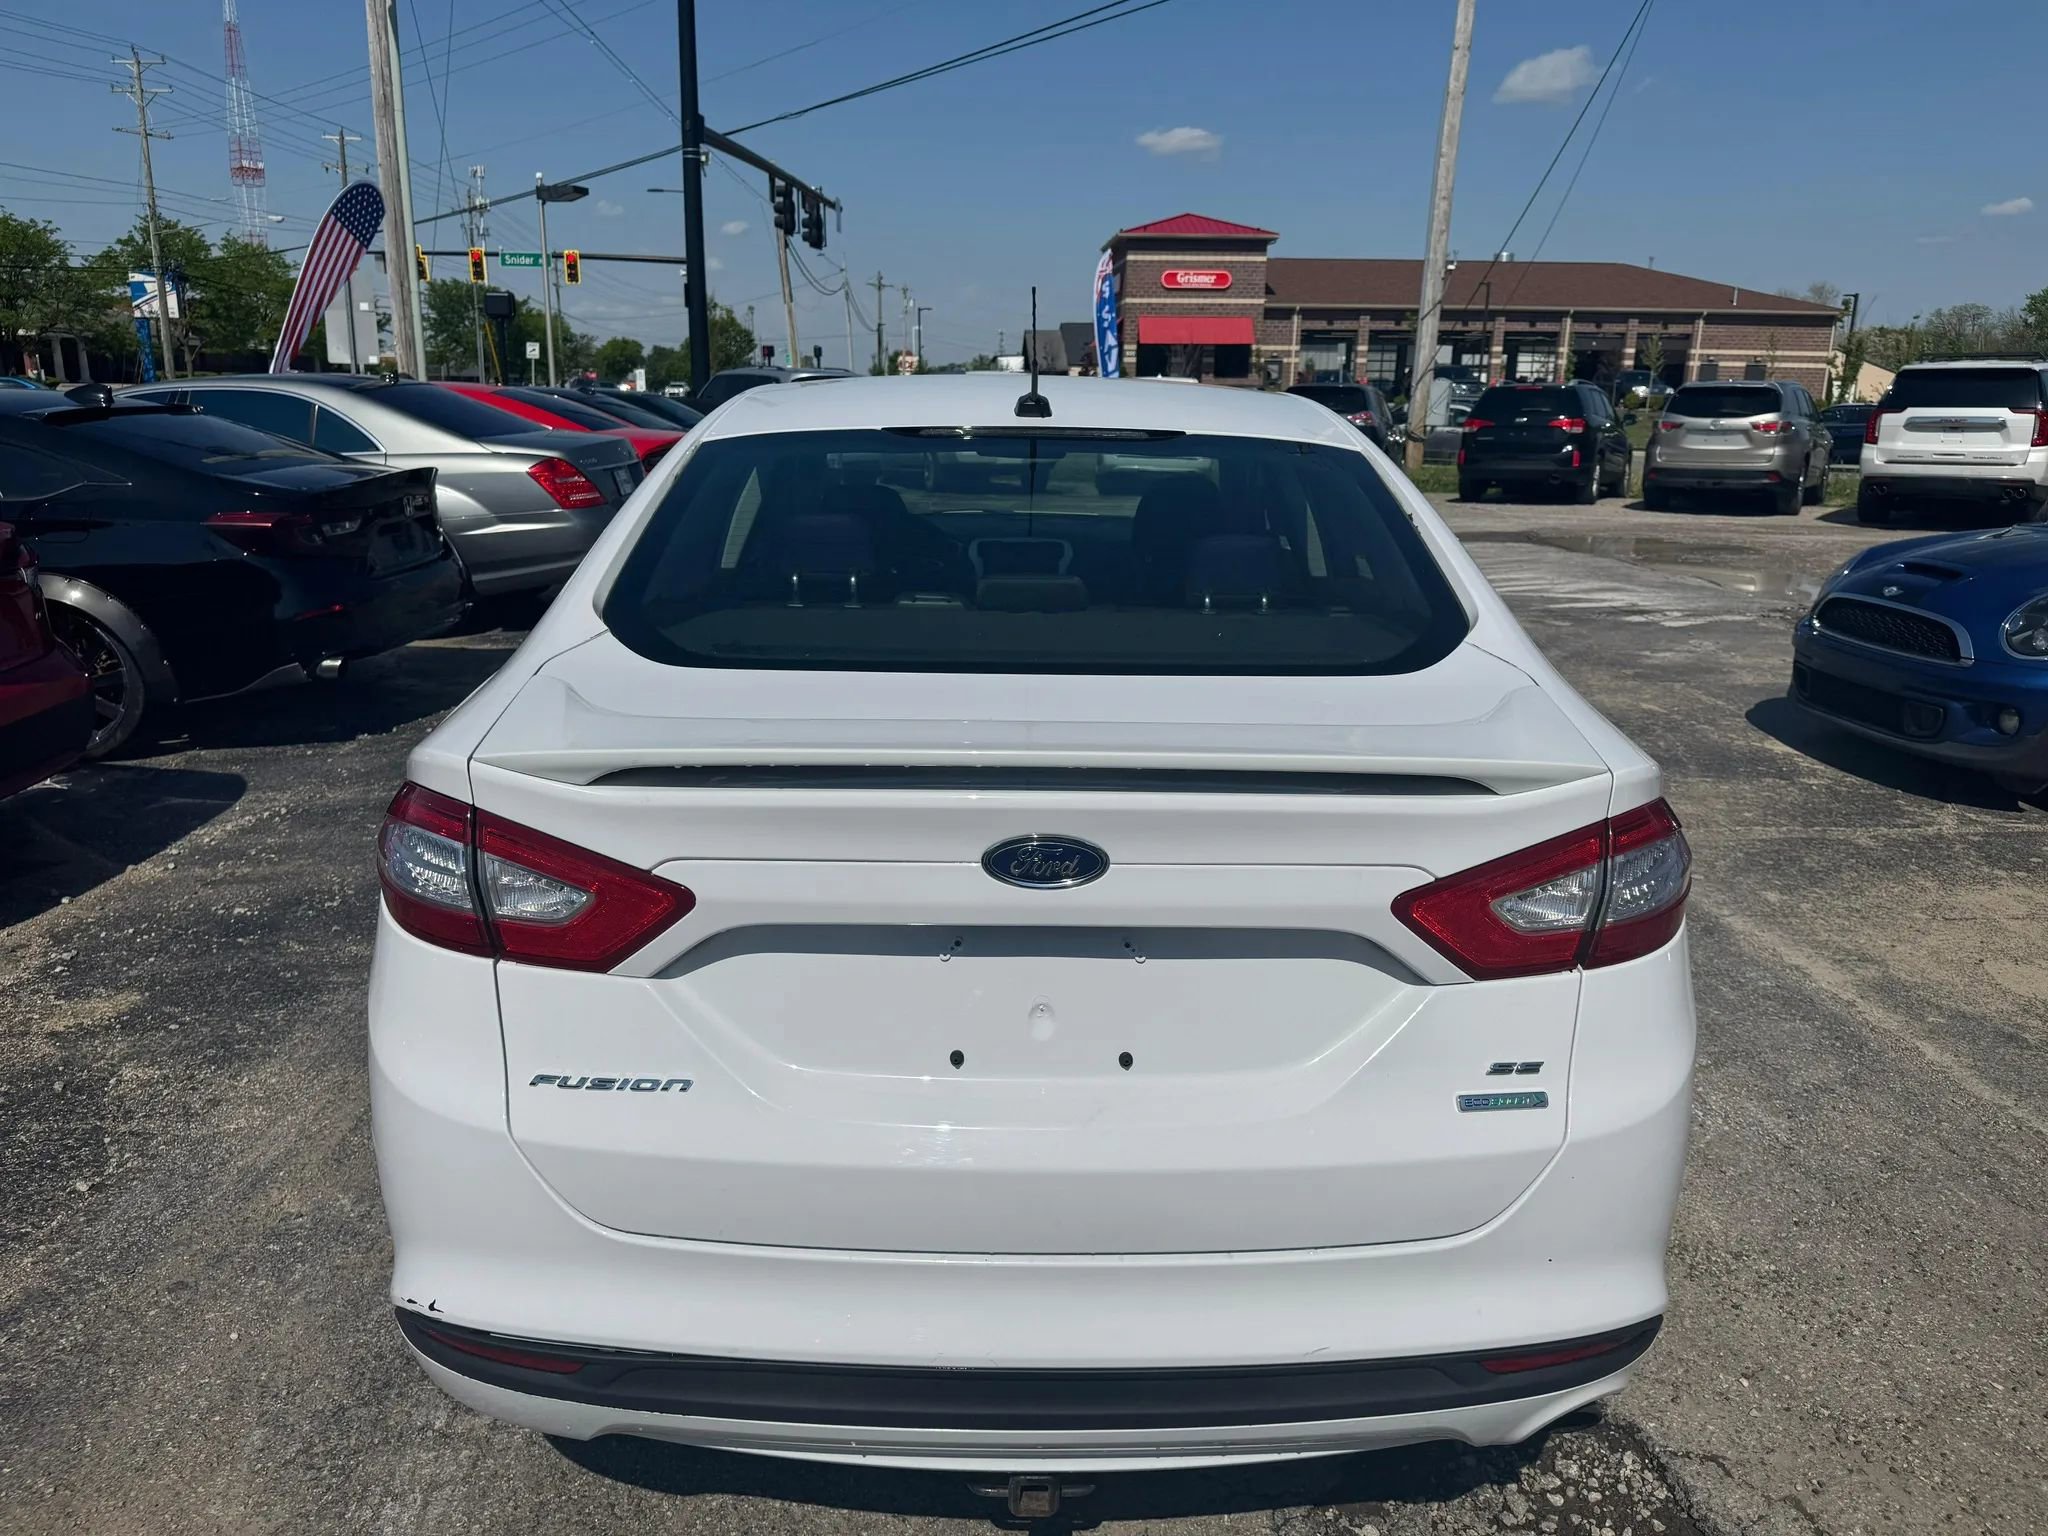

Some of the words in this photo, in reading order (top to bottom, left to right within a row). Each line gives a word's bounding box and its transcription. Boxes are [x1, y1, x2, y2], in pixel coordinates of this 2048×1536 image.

[504, 255, 534, 265] Snider
[1176, 271, 1217, 285] Grismer
[1010, 845, 1080, 876] Ford
[1485, 1061, 1544, 1075] SE
[529, 1074, 695, 1092] FUSION
